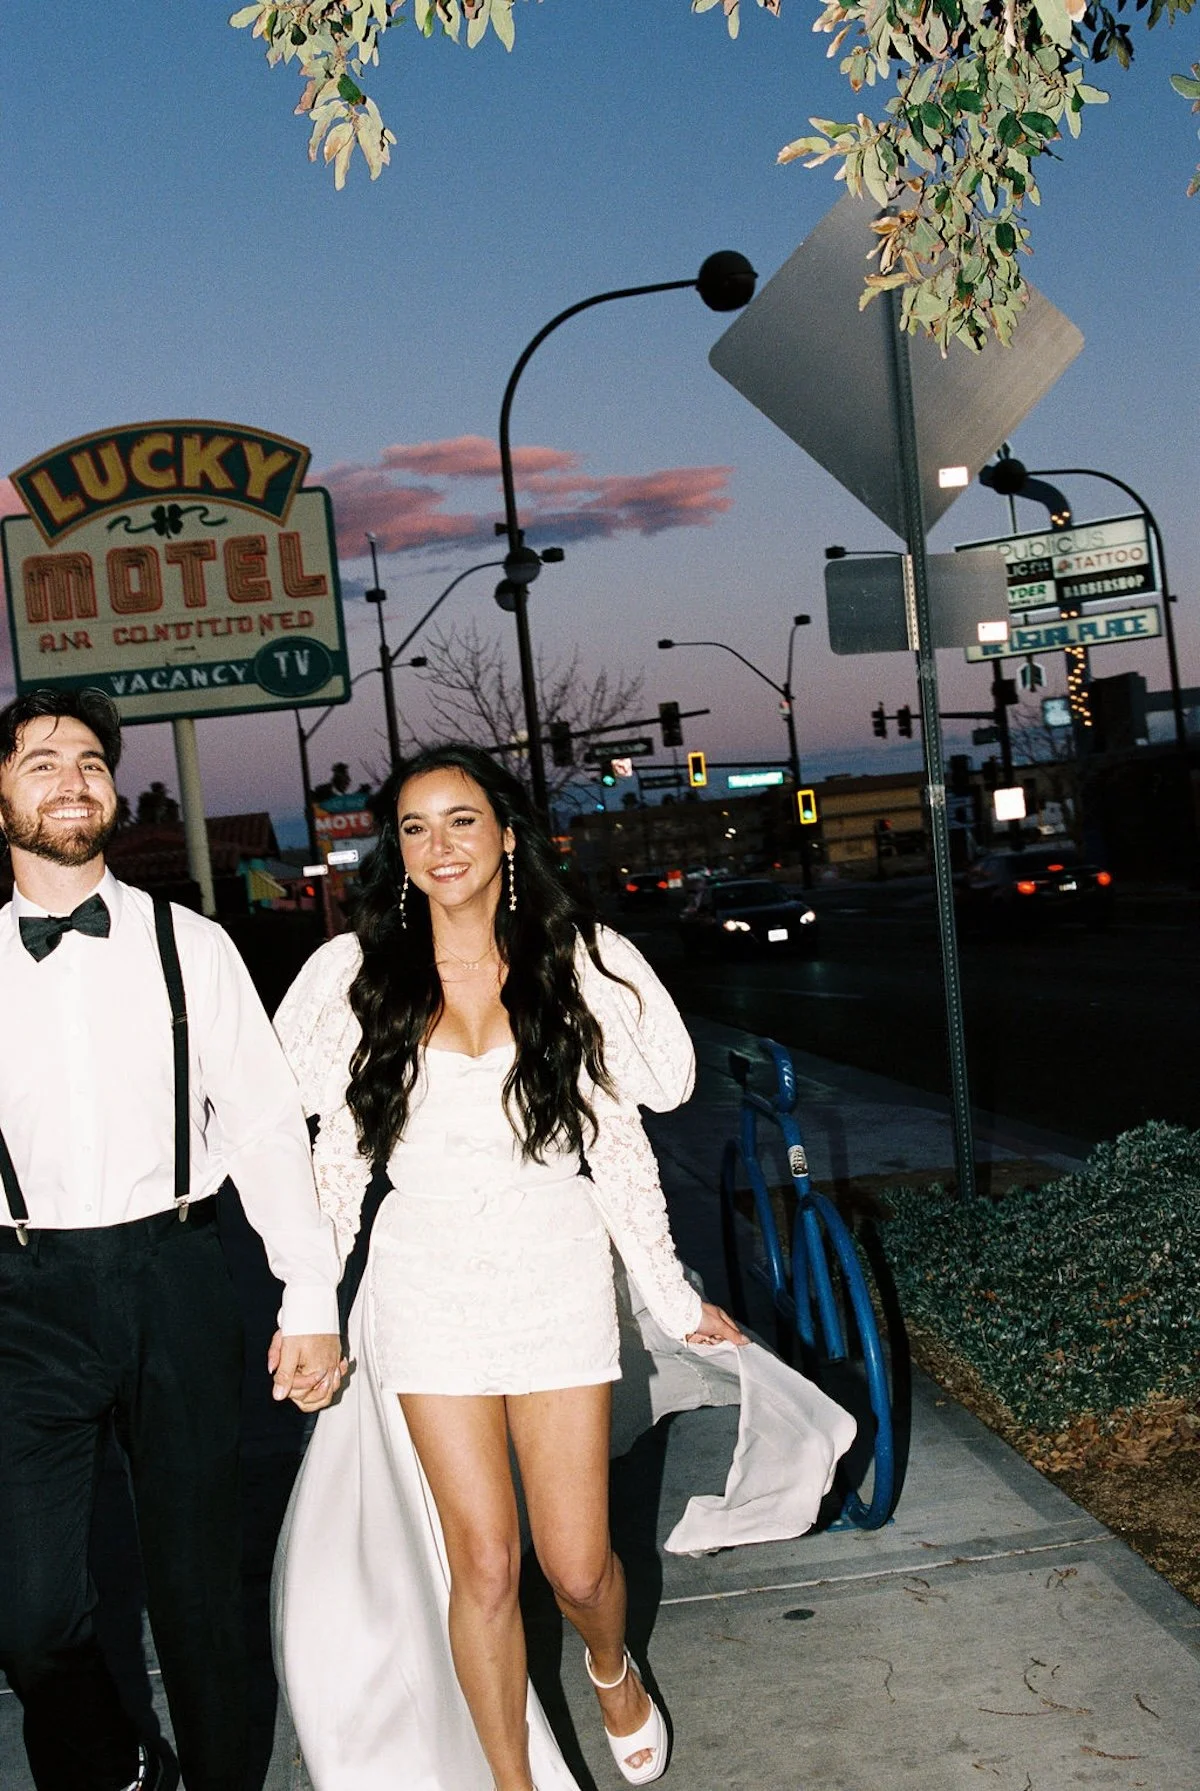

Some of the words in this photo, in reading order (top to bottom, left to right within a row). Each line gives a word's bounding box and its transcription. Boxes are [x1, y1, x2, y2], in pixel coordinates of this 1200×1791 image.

[29, 432, 294, 525] LUCKY
[1074, 547, 1143, 569] TATTOO
[22, 531, 328, 624] MOTEL
[1063, 574, 1145, 599] BARBERSHOP
[1009, 584, 1046, 599] YDER
[39, 630, 93, 652] AIR
[112, 610, 314, 646] CONDITIONED
[1078, 615, 1149, 642] PLACE
[273, 650, 310, 678] TV
[110, 664, 249, 694] VACANCY
[315, 812, 370, 832] MOTE
